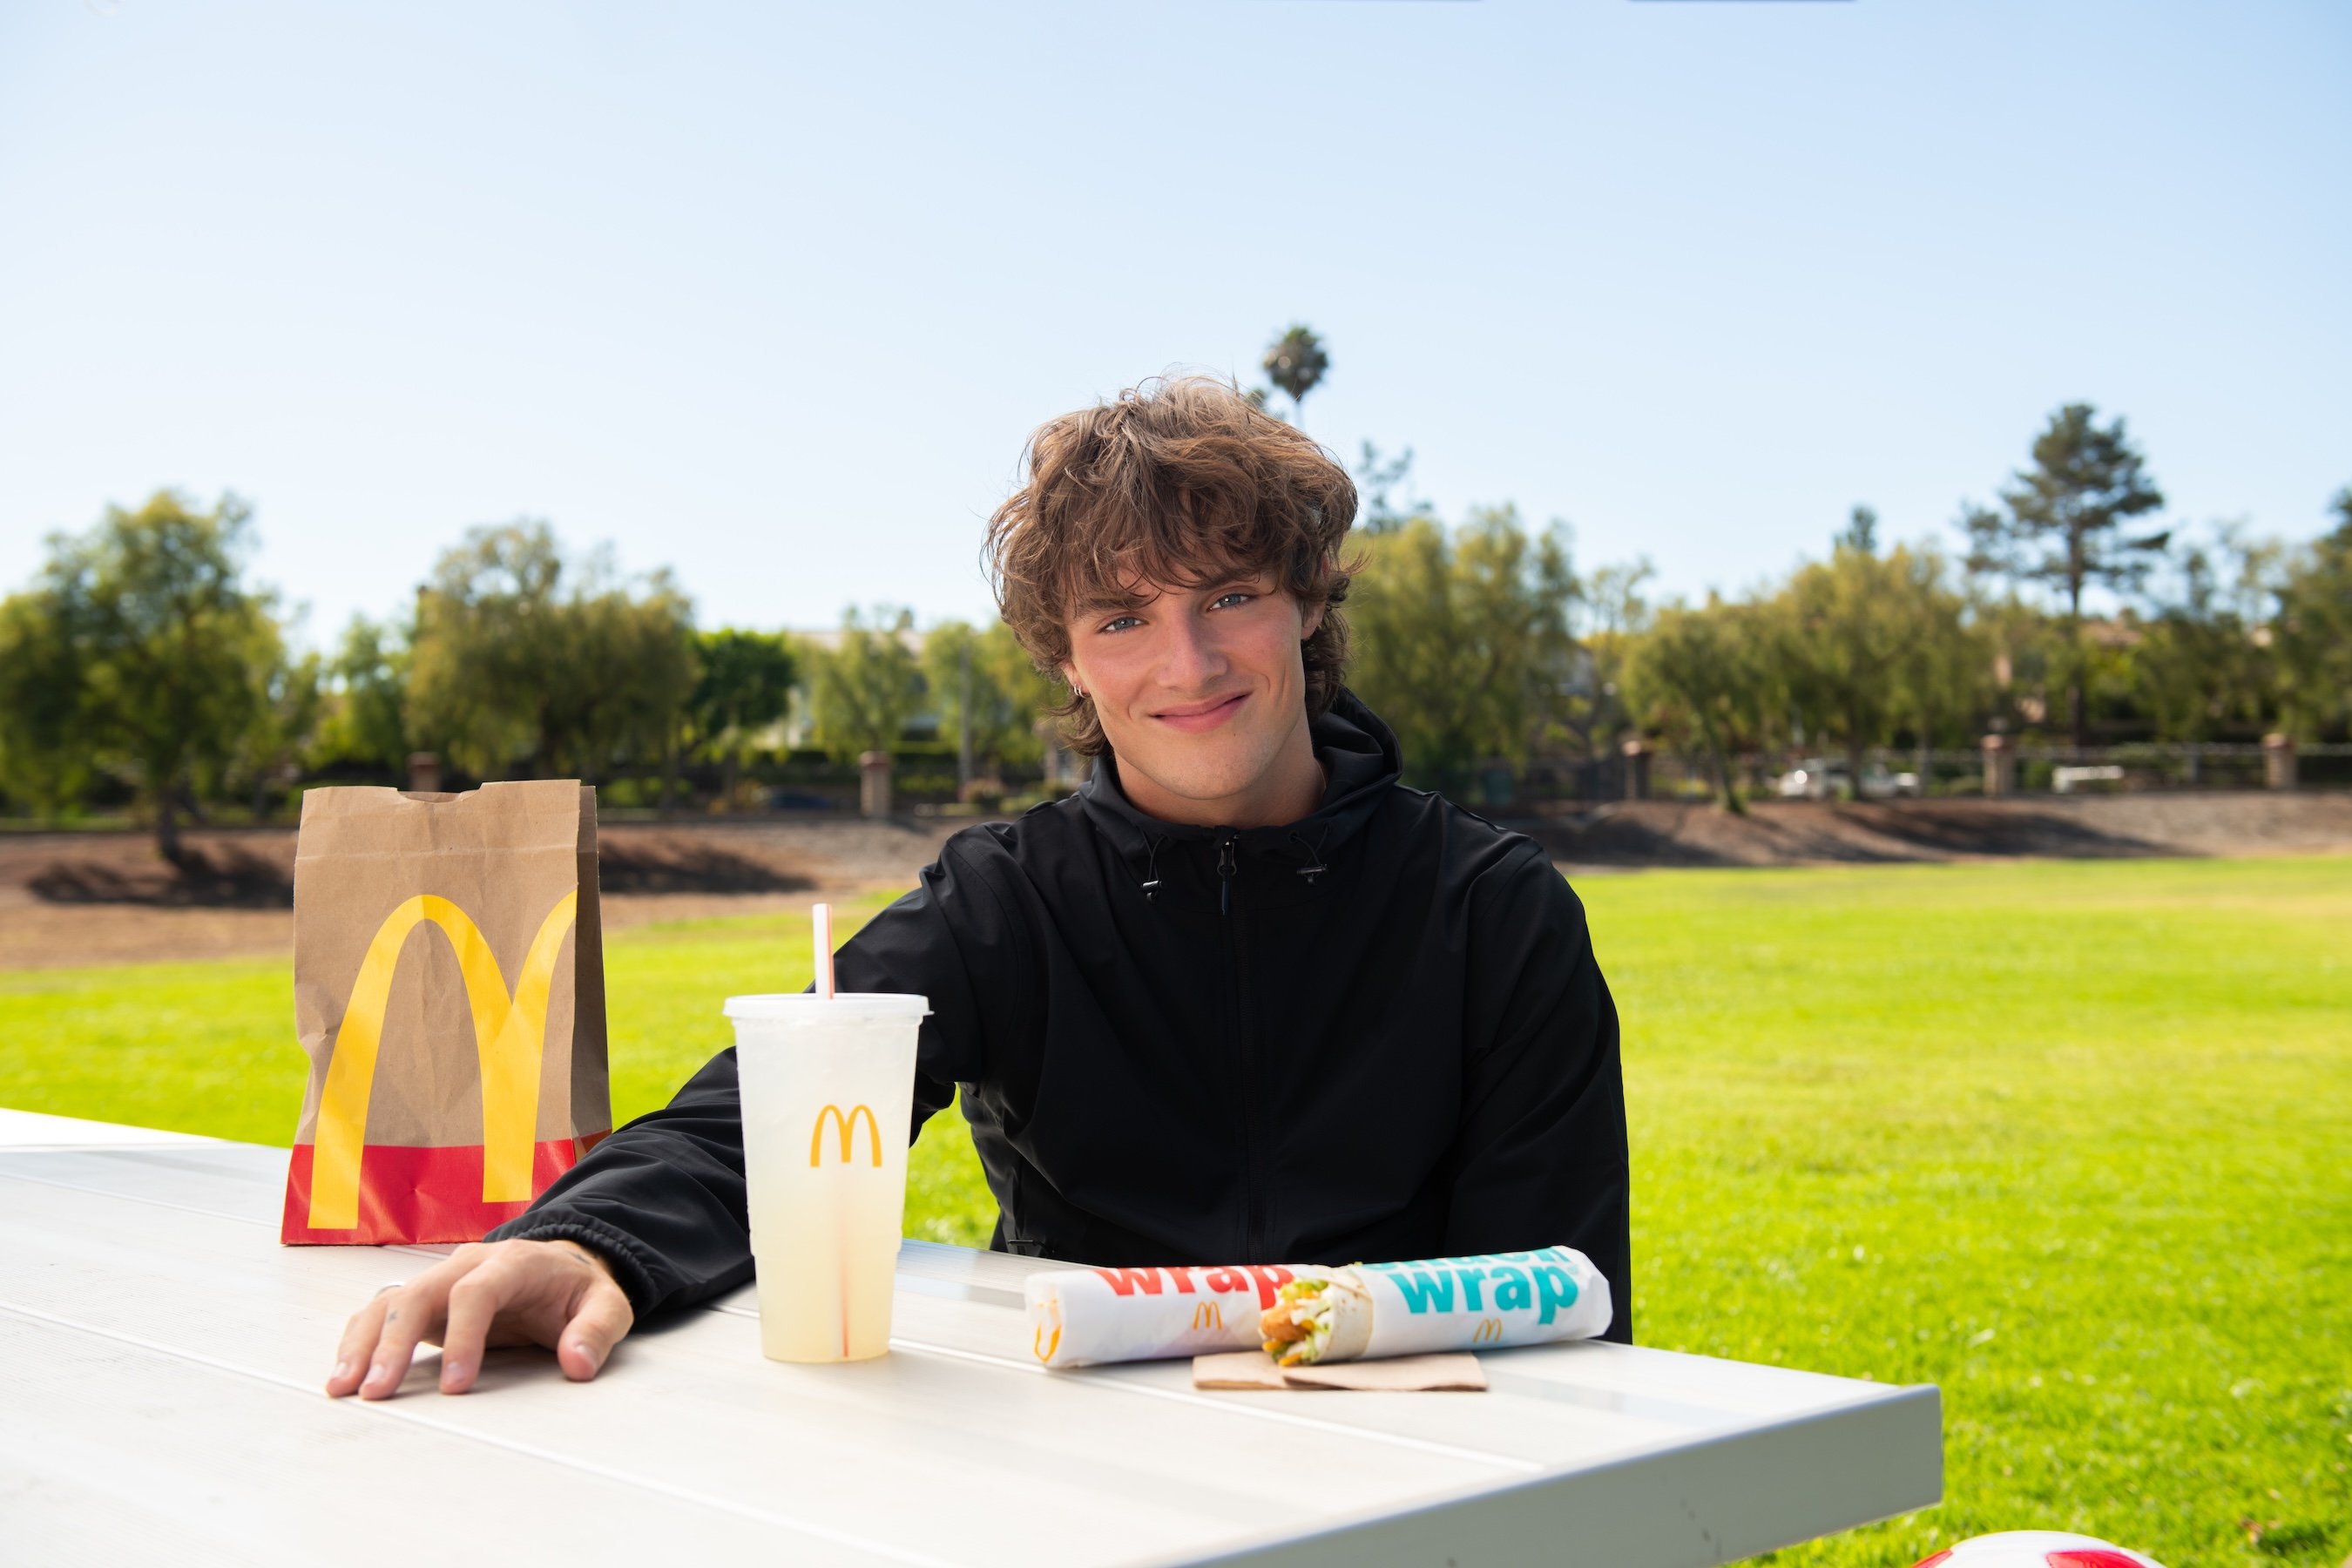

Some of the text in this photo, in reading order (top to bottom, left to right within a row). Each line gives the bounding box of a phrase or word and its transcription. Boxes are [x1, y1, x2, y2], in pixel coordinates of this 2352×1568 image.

[810, 1104, 882, 1168] M
[1093, 1264, 1294, 1311] wrap
[1387, 1265, 1578, 1325] wrap
[1193, 1301, 1222, 1331] M
[1472, 1317, 1504, 1343] M
